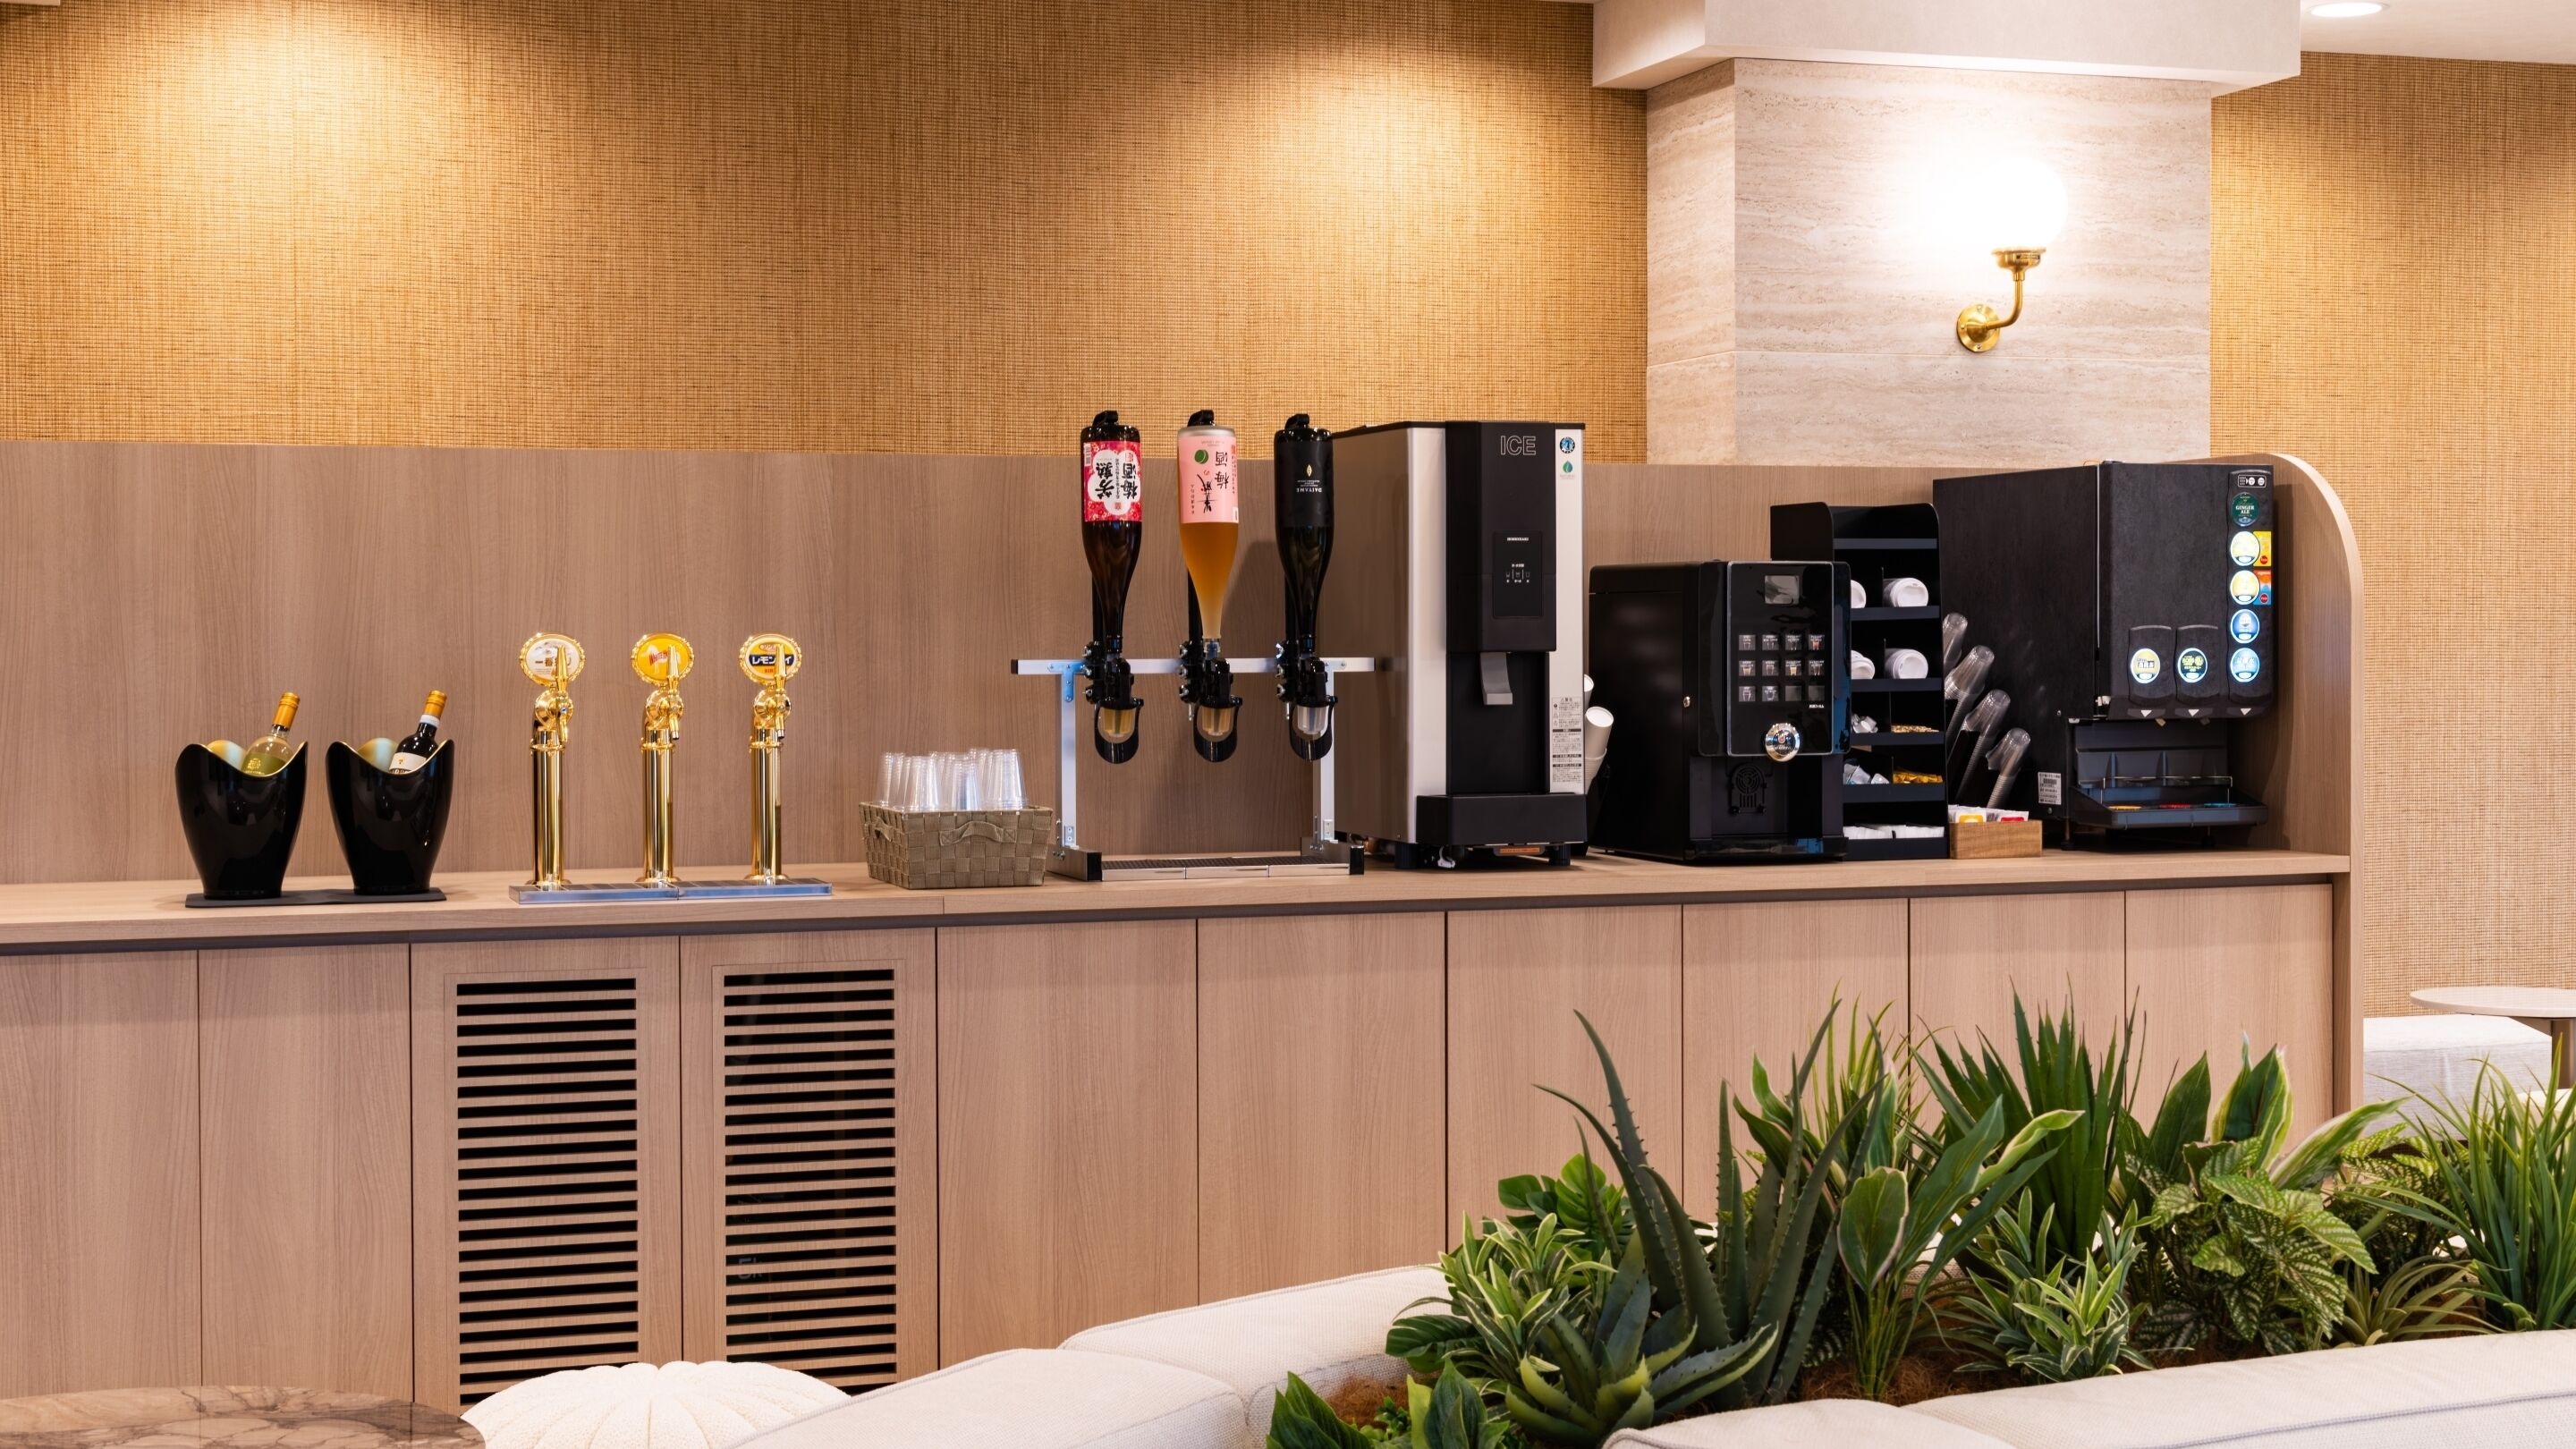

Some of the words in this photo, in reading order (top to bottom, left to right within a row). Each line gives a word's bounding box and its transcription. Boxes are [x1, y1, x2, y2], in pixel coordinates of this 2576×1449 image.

[1500, 435, 1537, 456] ICE
[1095, 462, 1115, 500] 芳熟
[1121, 462, 1139, 500] 梅酒
[1215, 451, 1230, 490] 梅酒
